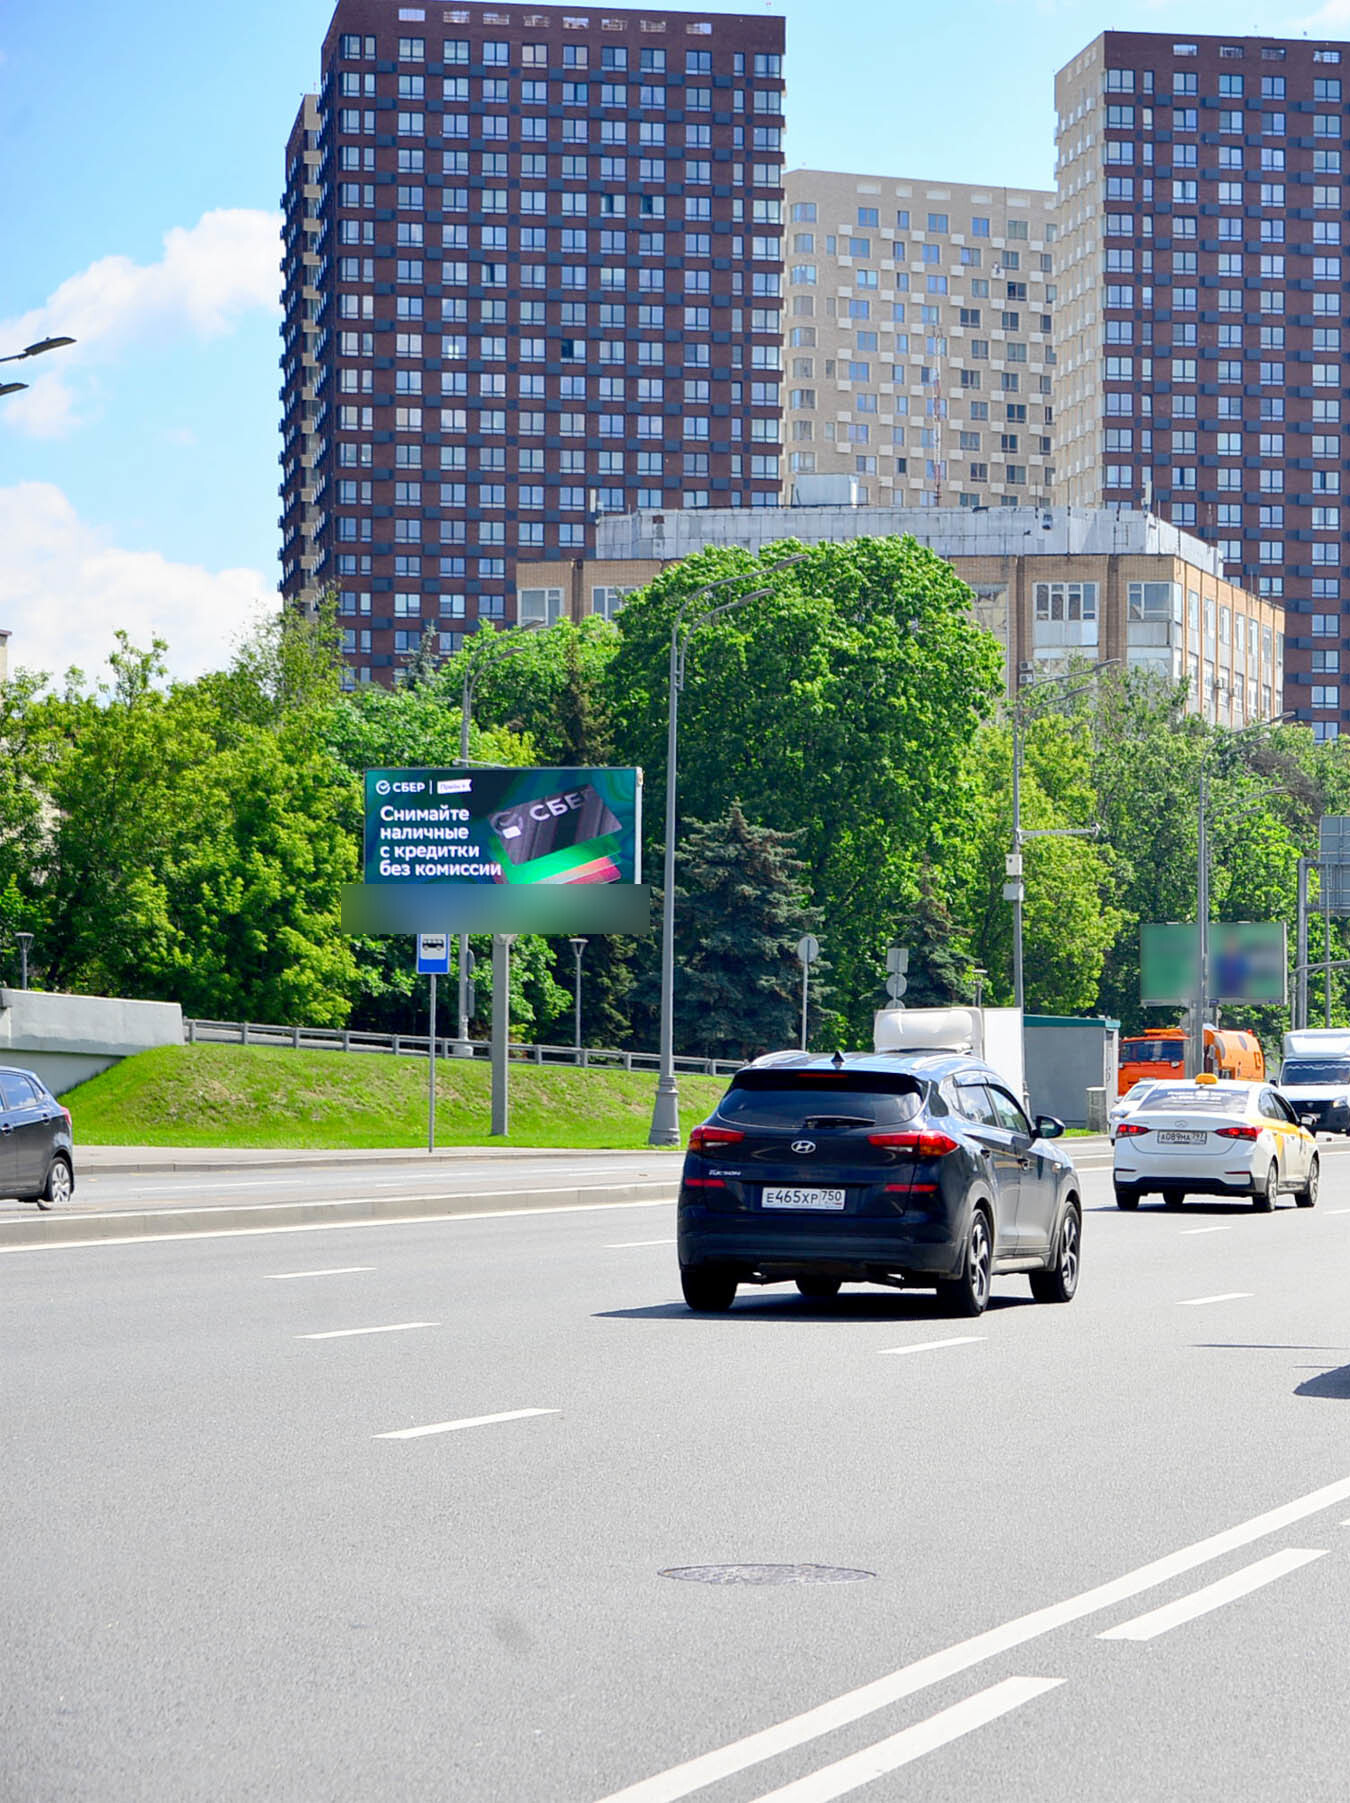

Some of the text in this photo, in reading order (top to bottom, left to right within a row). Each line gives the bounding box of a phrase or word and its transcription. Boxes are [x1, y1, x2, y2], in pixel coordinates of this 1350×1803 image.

[392, 782, 426, 793] СБЕР
[380, 804, 470, 821] Снимайте
[380, 827, 469, 840] наличные
[380, 845, 480, 861] с кредитки
[380, 860, 502, 876] без комиссии
[820, 1190, 842, 1201] 750
